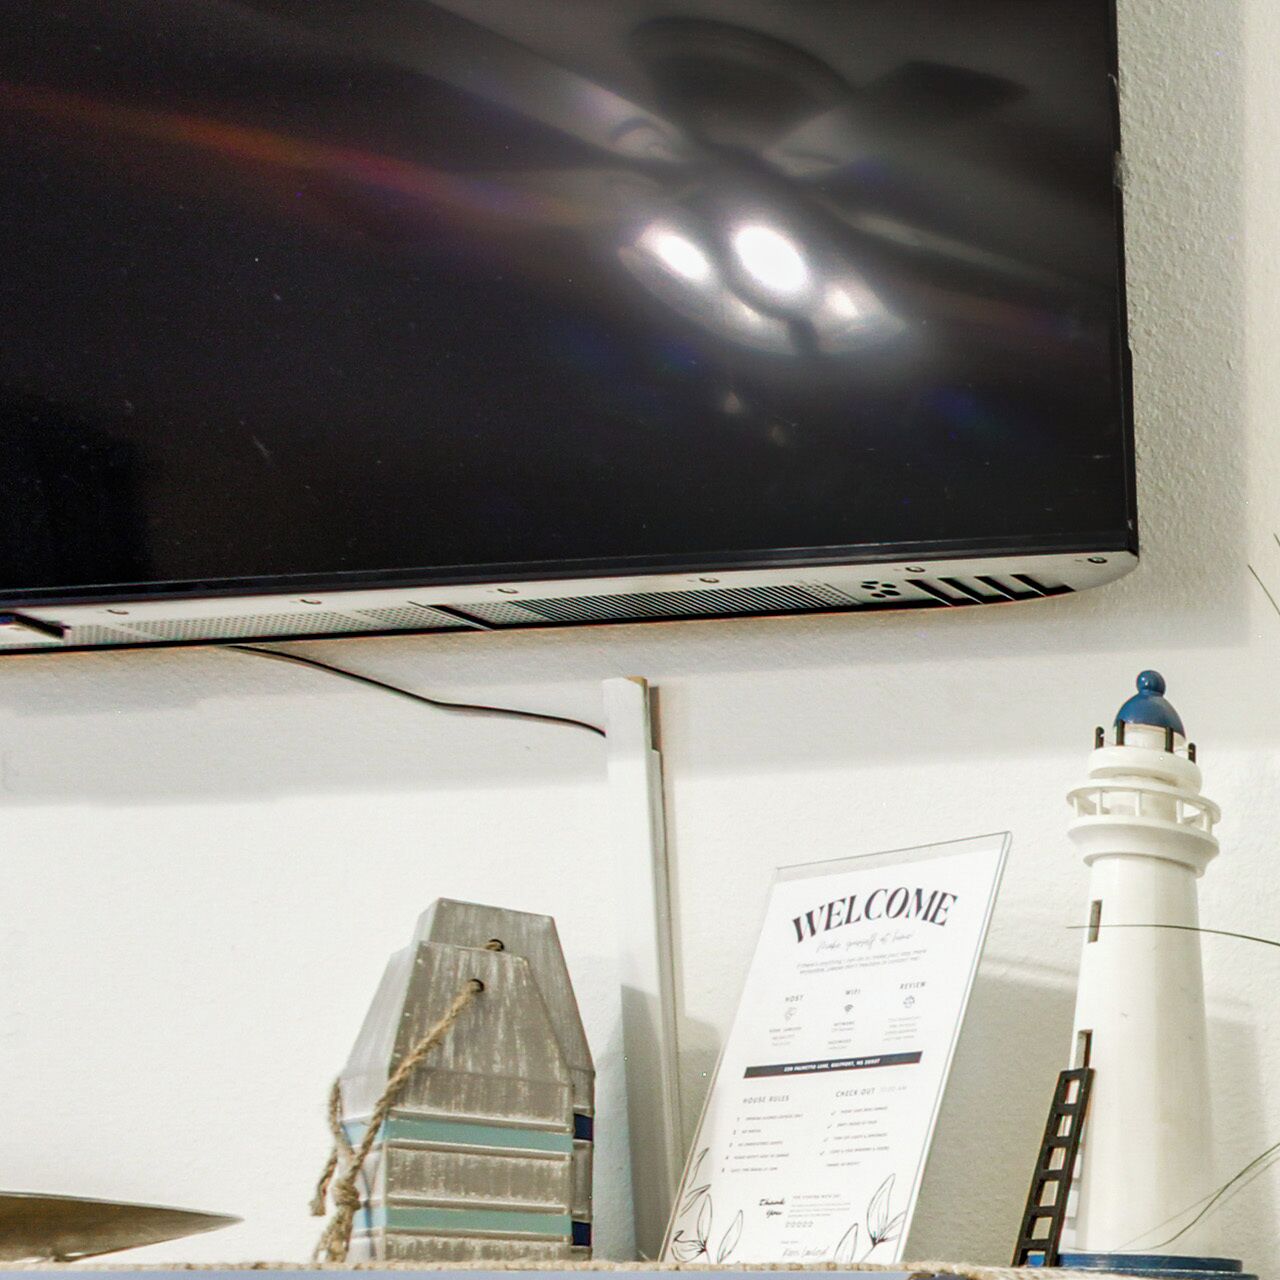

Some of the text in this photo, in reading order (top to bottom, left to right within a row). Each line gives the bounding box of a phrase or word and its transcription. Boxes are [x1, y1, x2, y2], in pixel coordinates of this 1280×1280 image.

[792, 886, 958, 944] WELCOME
[835, 1089, 858, 1097] CHECK
[861, 1087, 875, 1096] OUT
[743, 1094, 789, 1104] HOUSE RULES
